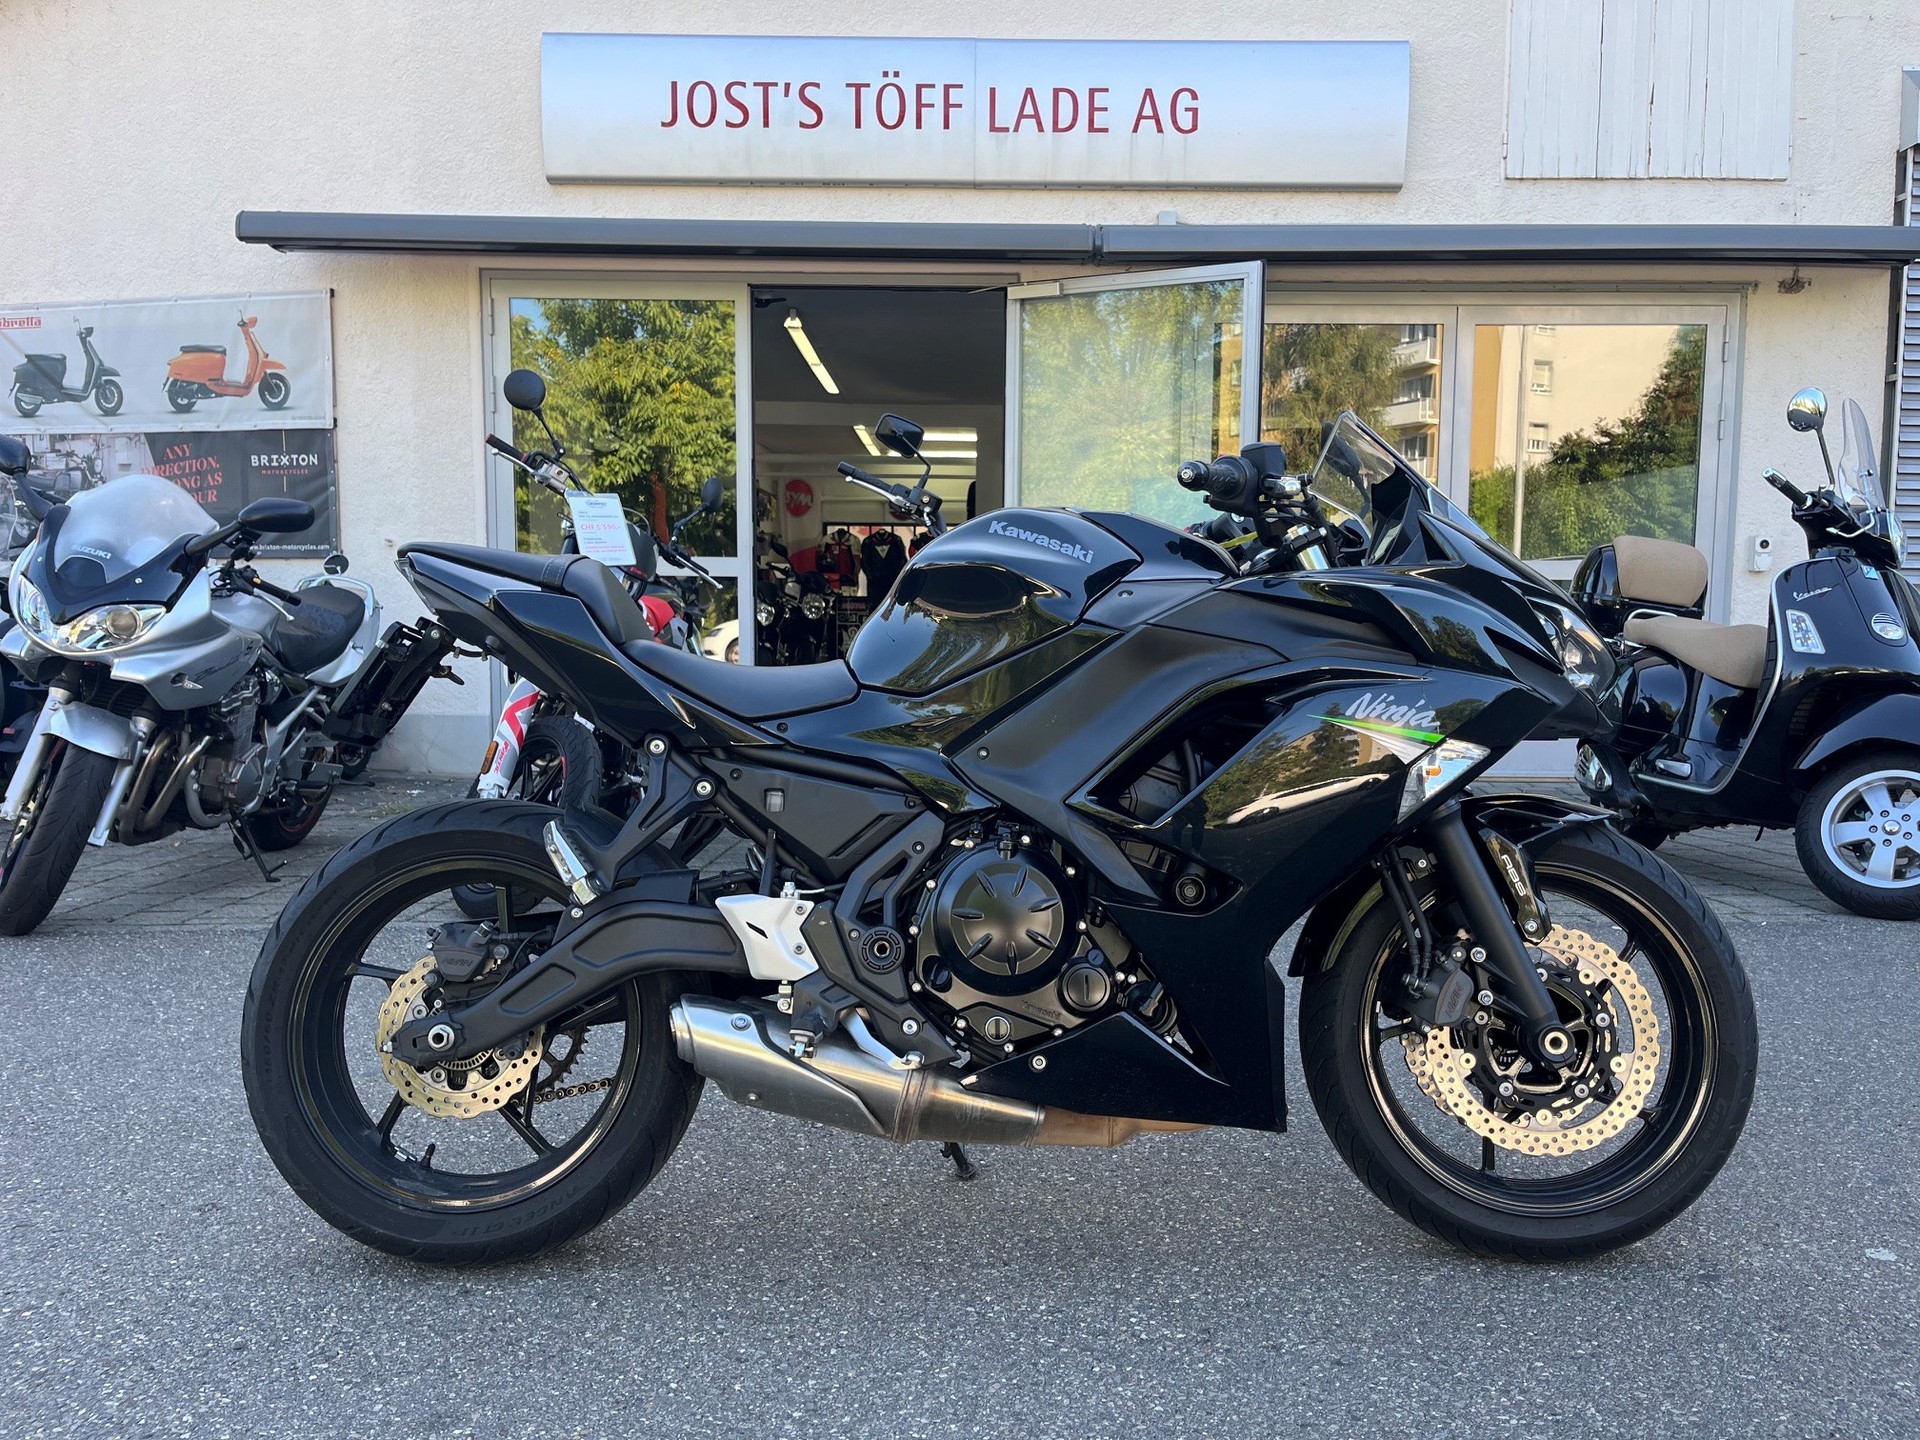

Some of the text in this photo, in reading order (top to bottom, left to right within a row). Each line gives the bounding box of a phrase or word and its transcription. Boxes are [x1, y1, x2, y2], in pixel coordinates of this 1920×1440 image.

[660, 70, 1199, 135] JOST'S TÖFF LADE AG
[163, 443, 193, 460] ANY
[250, 452, 319, 468] BRIXTON
[204, 471, 223, 487] AS
[988, 520, 1095, 564] Kawasaki
[71, 544, 112, 560] SUZUKI
[1792, 586, 1833, 602] Vespa
[1345, 692, 1441, 728] Ninja
[1501, 854, 1527, 897] ABS
